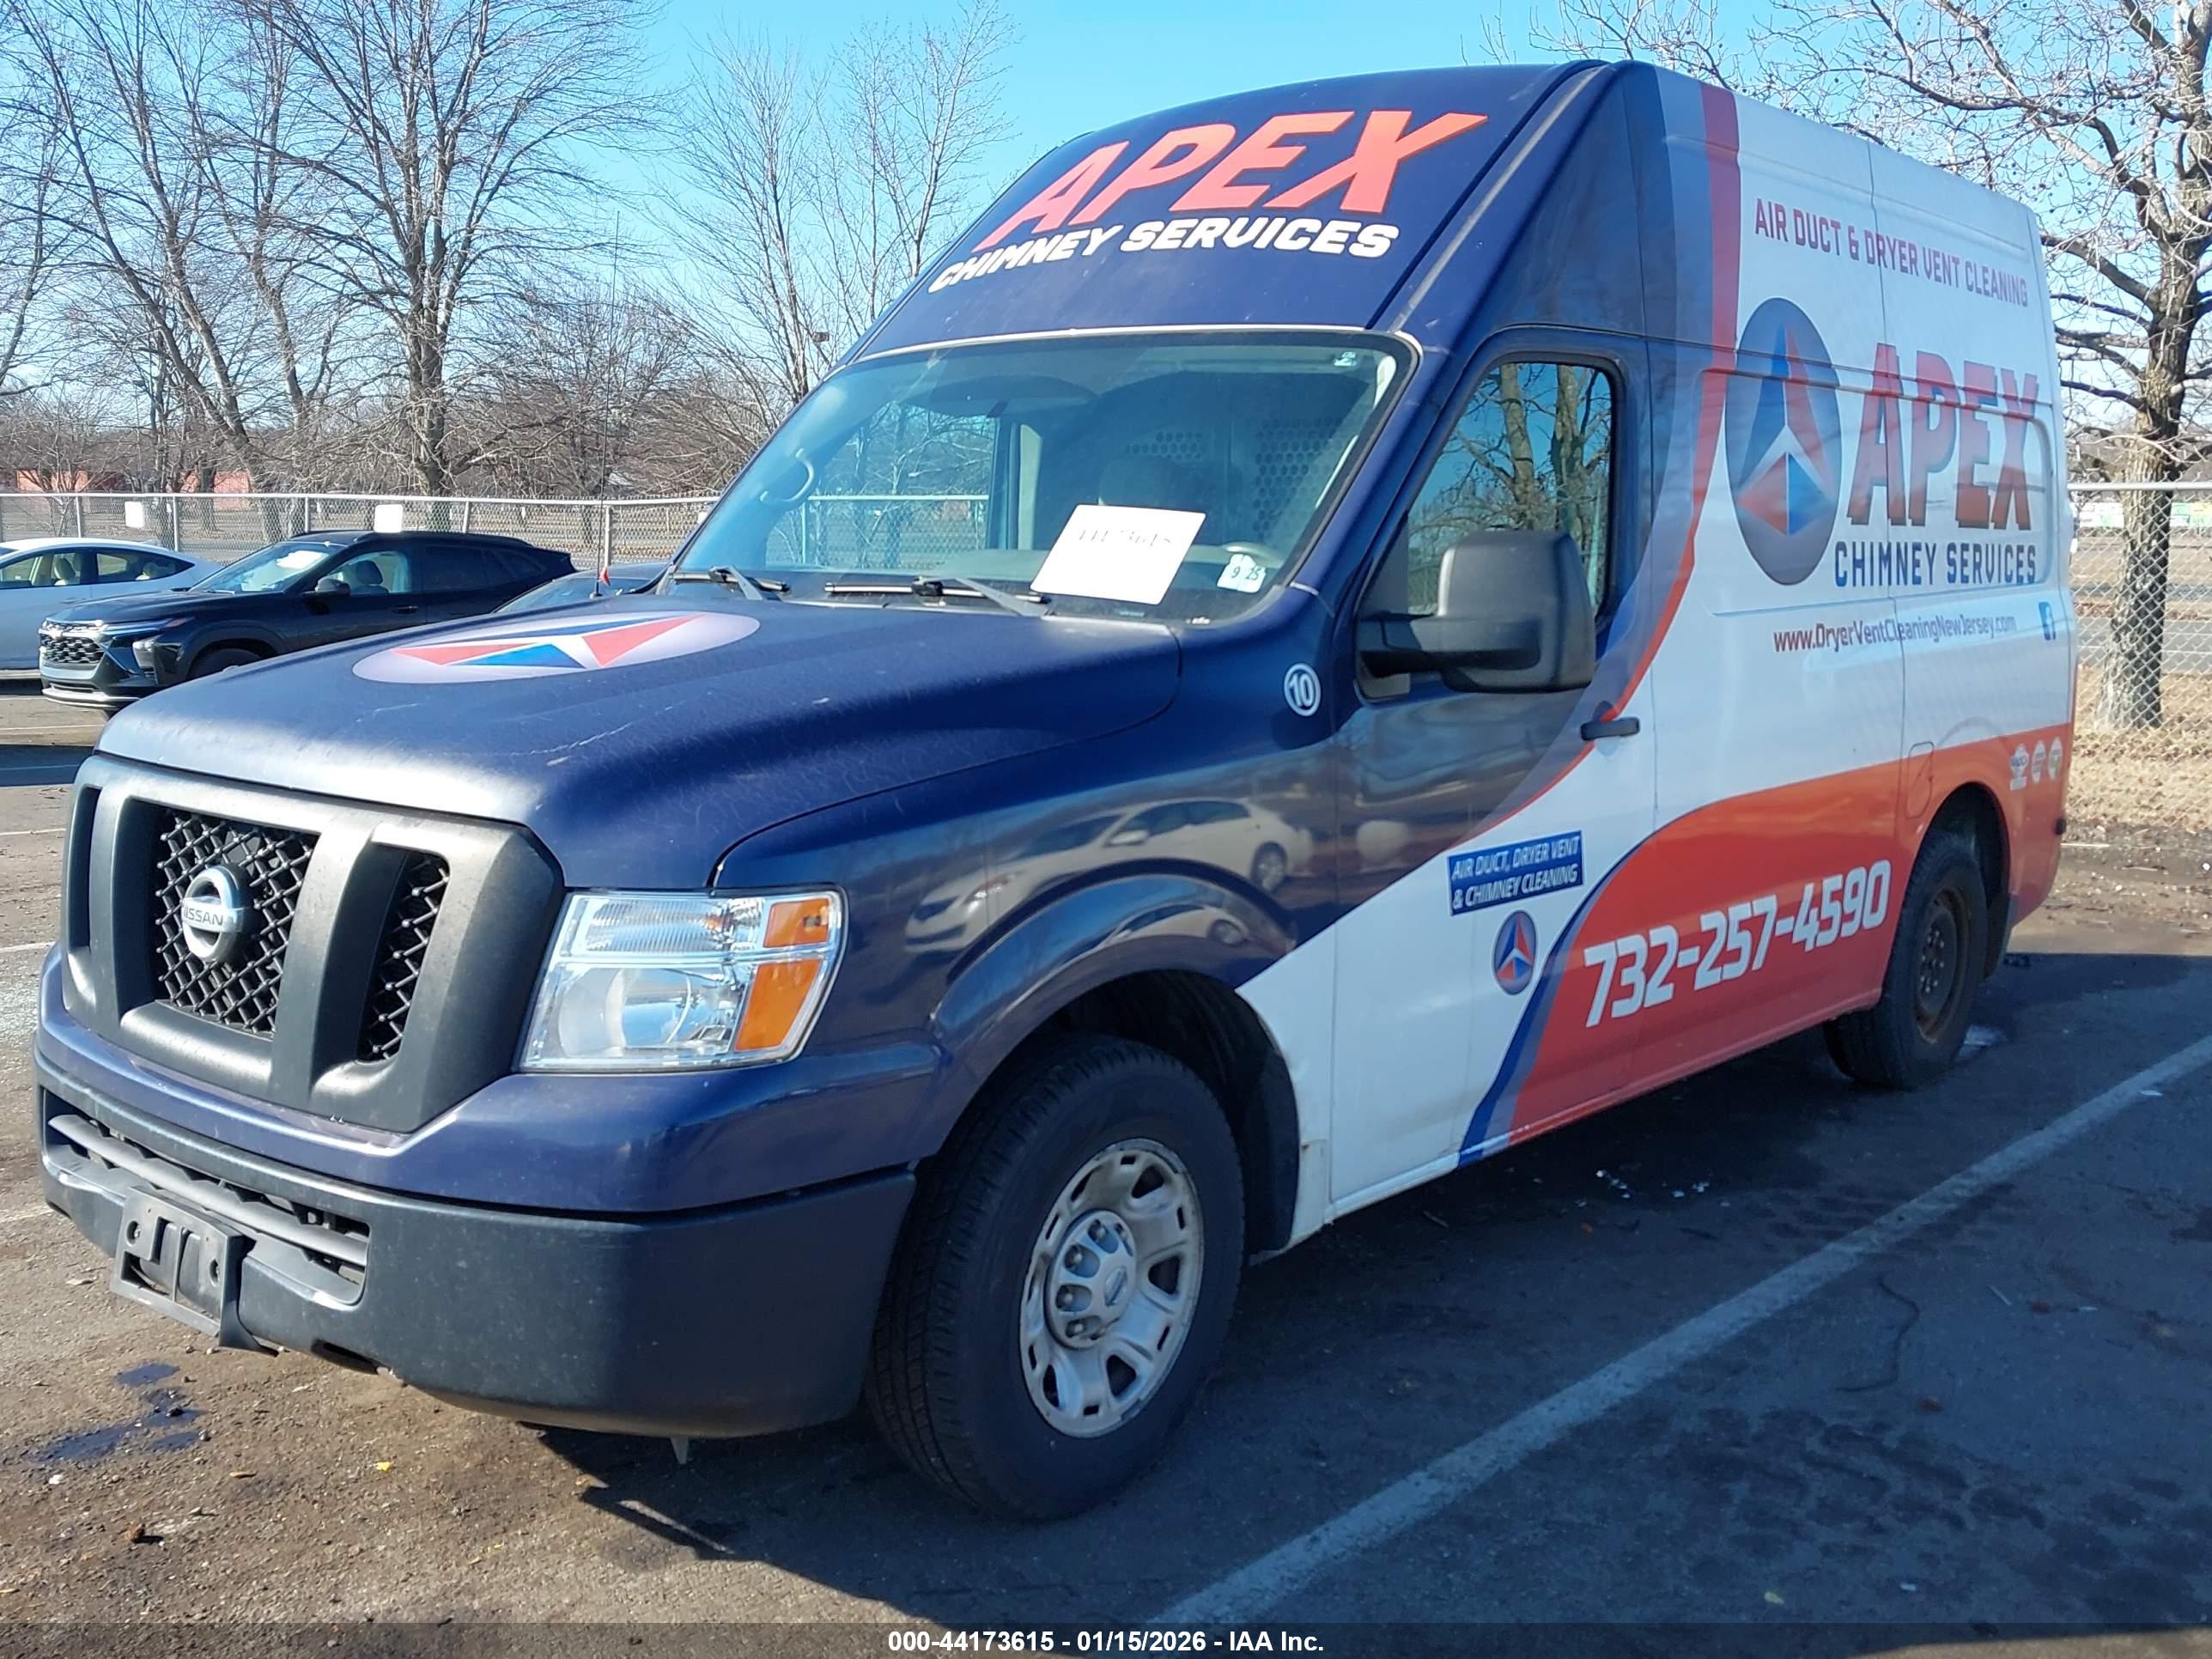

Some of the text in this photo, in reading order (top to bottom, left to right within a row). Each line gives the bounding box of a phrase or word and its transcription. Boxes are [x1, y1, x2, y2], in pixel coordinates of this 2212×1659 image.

[971, 110, 1488, 253] APEX
[928, 217, 1400, 294] CHIMNEY SERVICES
[1755, 198, 2027, 307] AIR DUCT & DRYER VENT CLEANING
[1846, 343, 2039, 530] APEX
[1835, 541, 2036, 587] CHIMNEY SERVICES
[1773, 614, 2016, 653] www.DryerVentCleaningNewJersey.com
[1289, 672, 1314, 707] 10
[1451, 836, 1580, 880] AIR DUCT, DRYER VENT
[1452, 863, 1578, 910] & CHIMNEY CLEANING
[1583, 860, 1891, 1028] 732-257-4590
